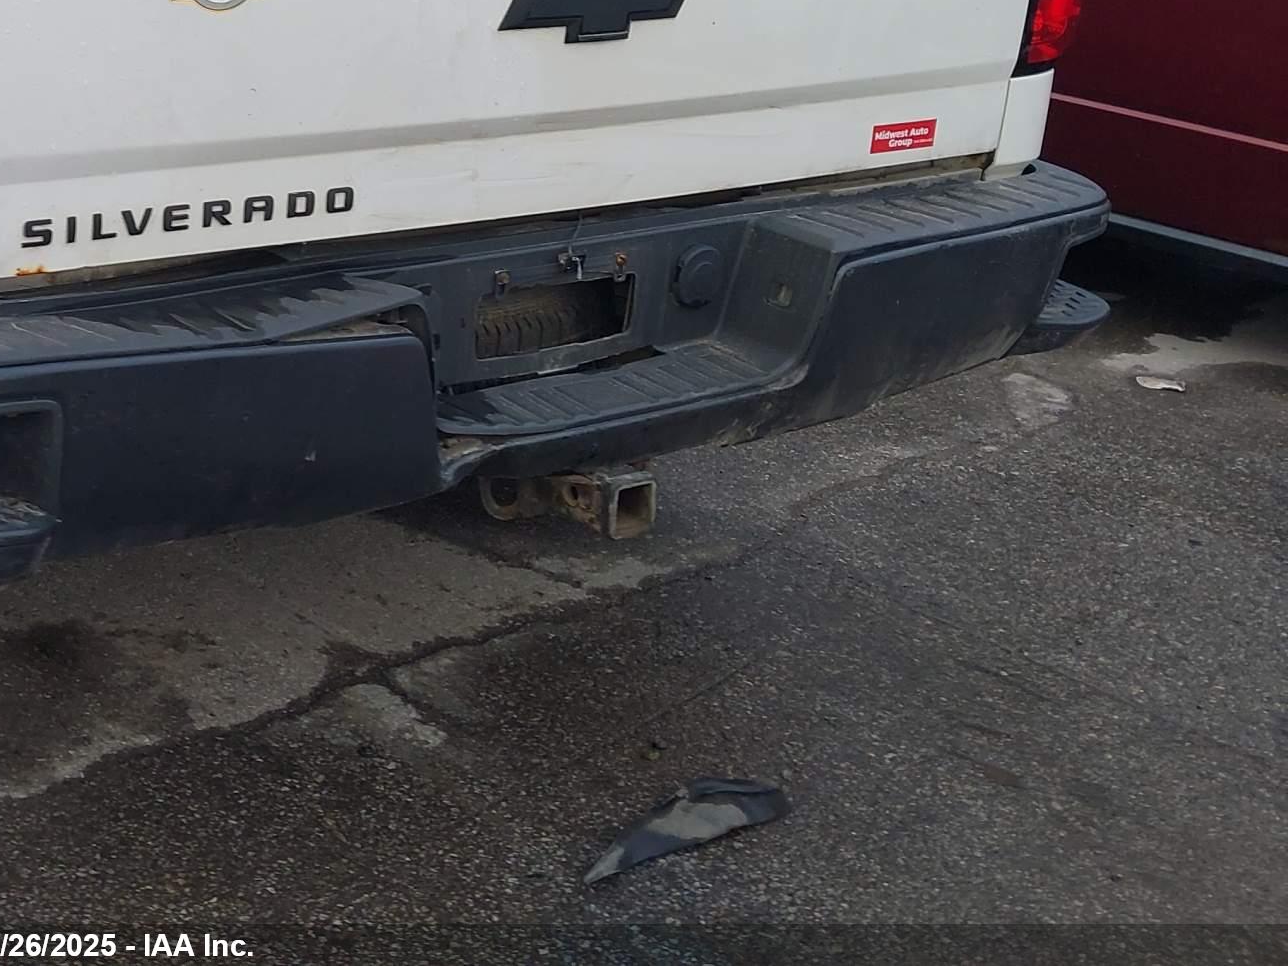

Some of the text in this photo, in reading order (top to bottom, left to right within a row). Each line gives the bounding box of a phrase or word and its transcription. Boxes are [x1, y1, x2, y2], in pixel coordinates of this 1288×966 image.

[874, 129, 908, 141] Midwest
[910, 127, 929, 137] Auto
[888, 138, 913, 148] Group
[21, 186, 355, 248] SILVERADO
